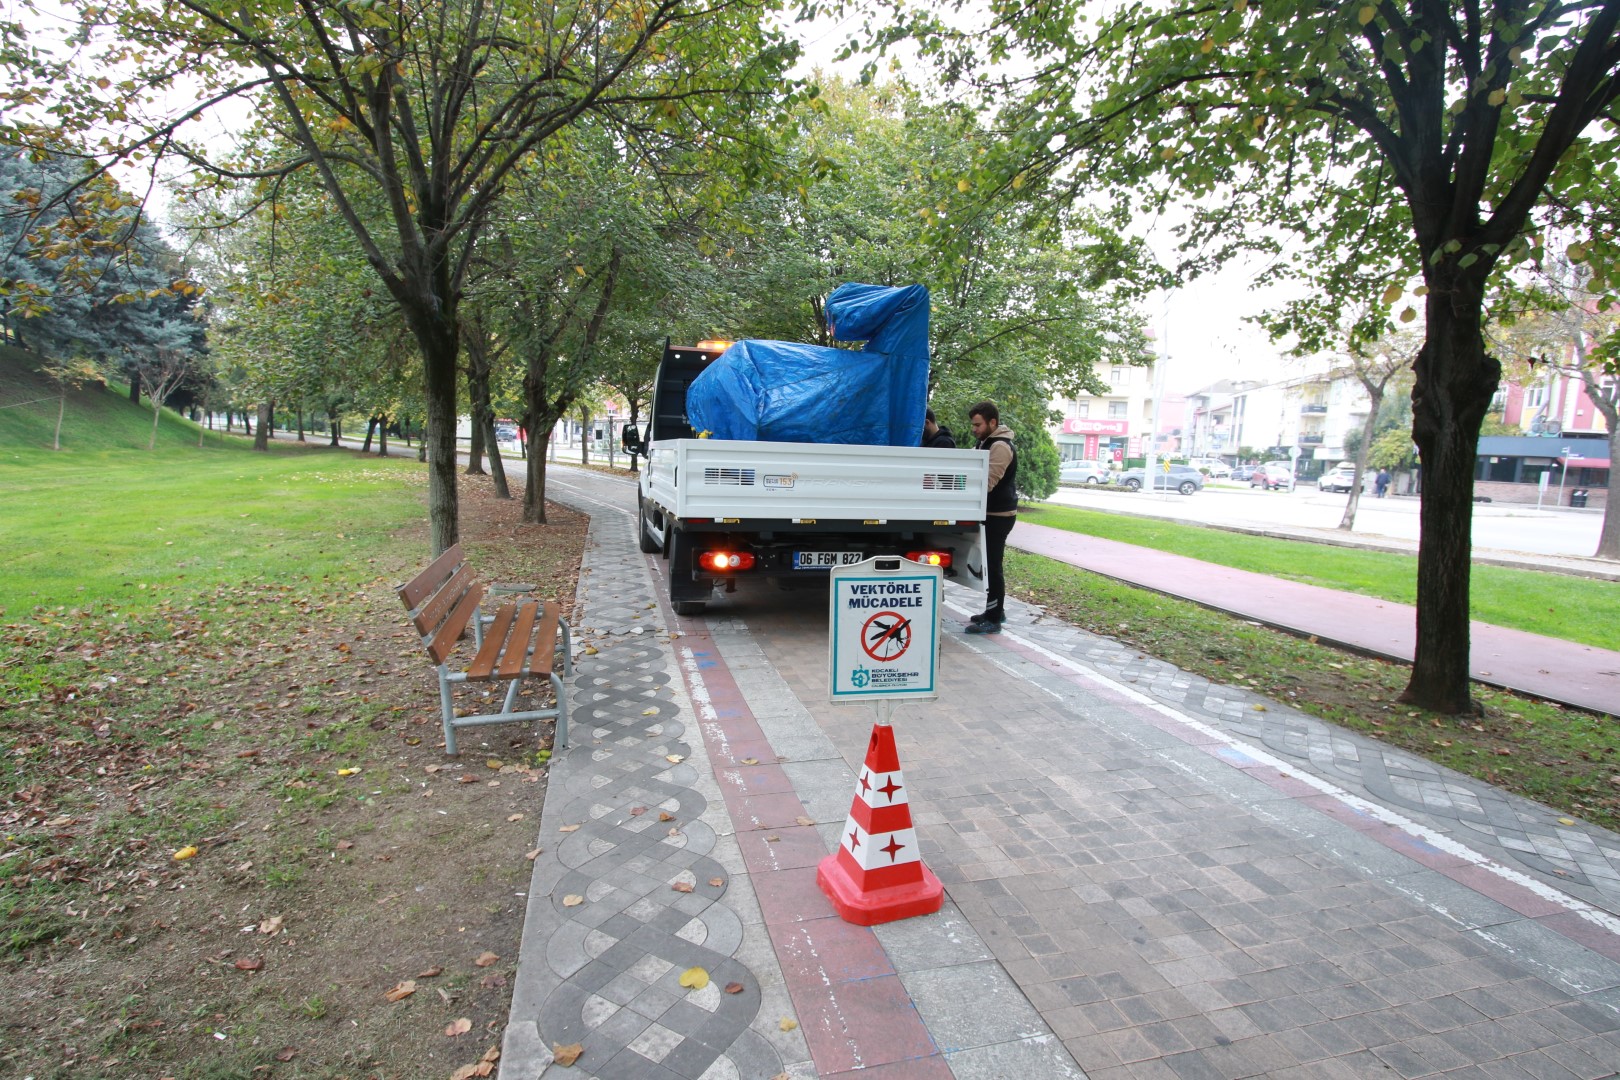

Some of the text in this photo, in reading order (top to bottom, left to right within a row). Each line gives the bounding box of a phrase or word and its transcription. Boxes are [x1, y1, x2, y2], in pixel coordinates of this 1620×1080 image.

[780, 477, 792, 485] 153
[799, 479, 882, 488] TRANSIT
[800, 553, 861, 565] 06 FGM 822
[850, 582, 921, 595] VEKTÖRLE
[848, 596, 923, 608] MÜCADELE
